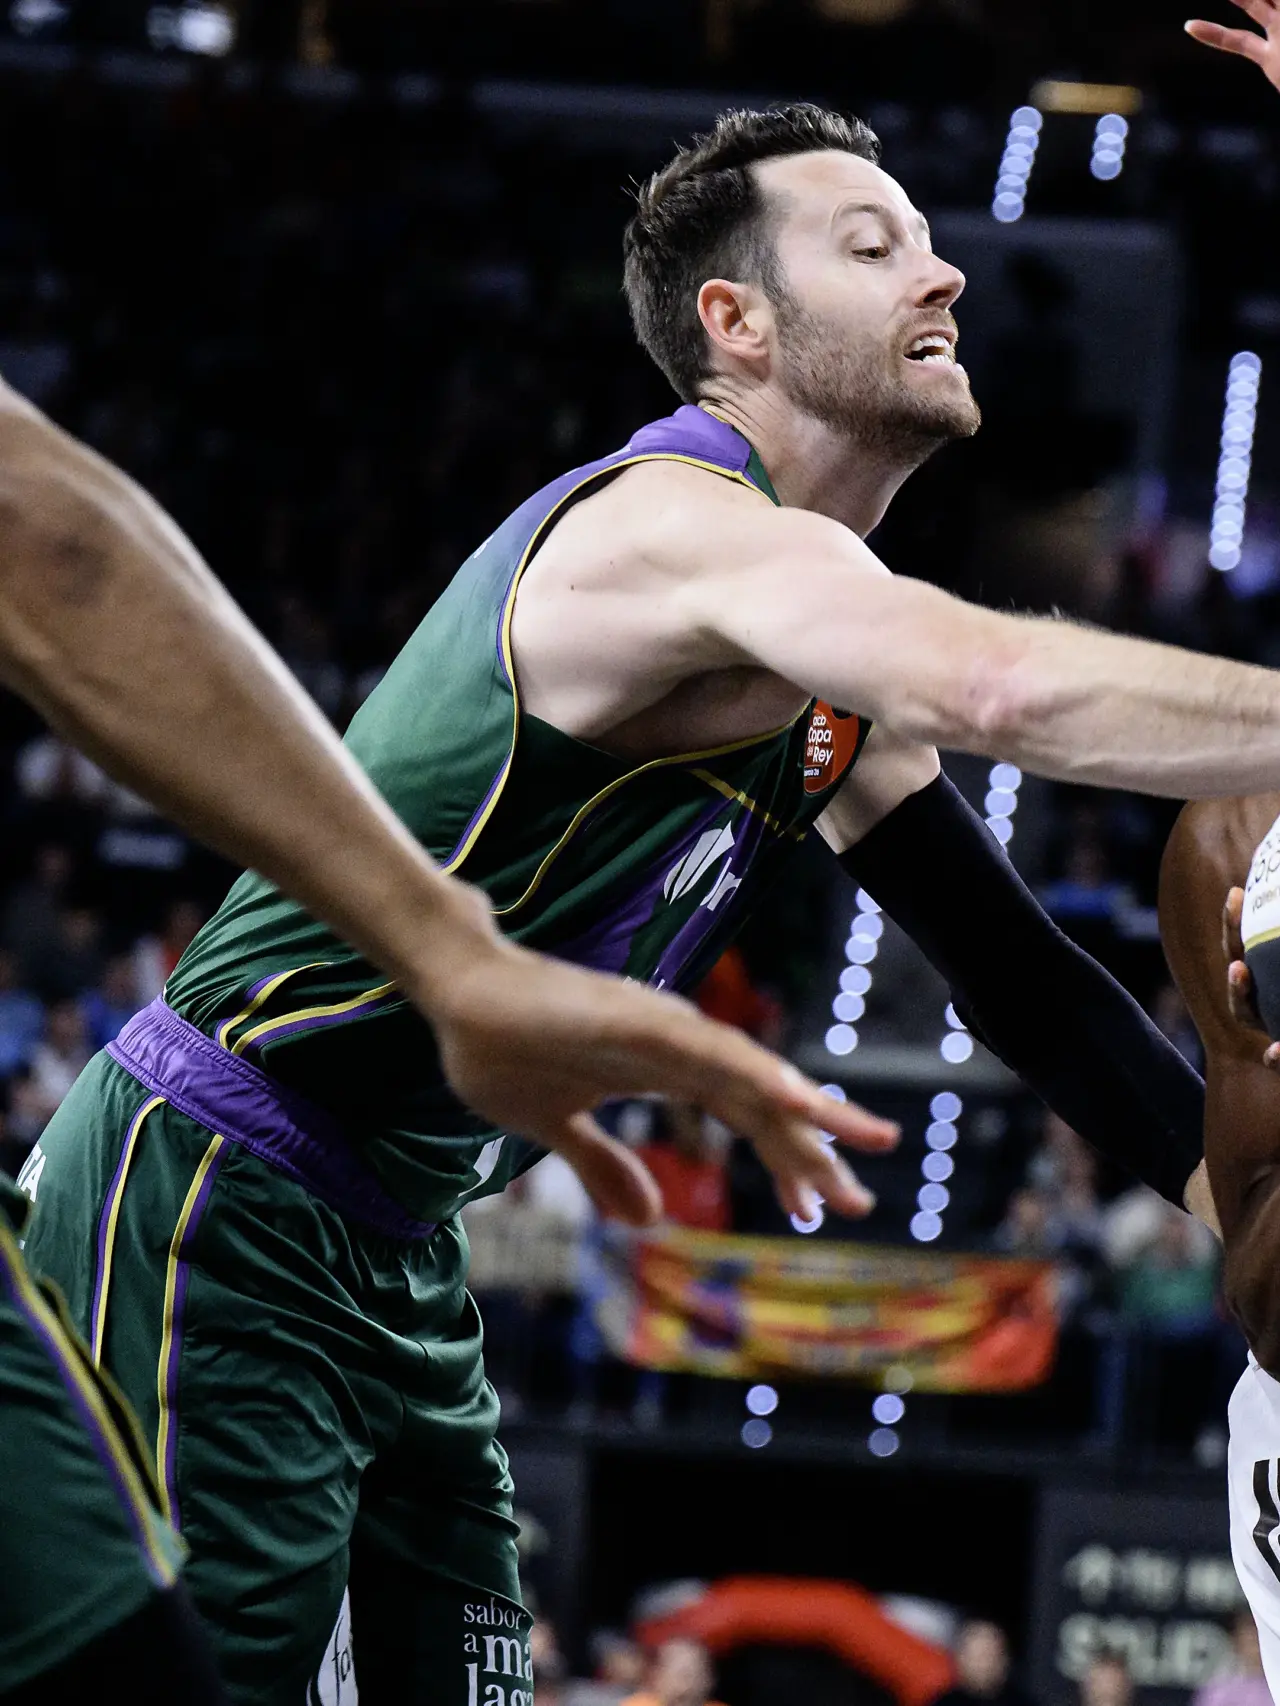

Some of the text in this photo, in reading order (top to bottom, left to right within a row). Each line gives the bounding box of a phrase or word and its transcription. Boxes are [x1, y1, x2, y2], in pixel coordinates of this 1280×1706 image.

[813, 714, 826, 726] acb
[808, 727, 832, 745] Copa
[813, 745, 833, 766] Rey
[463, 1597, 526, 1630] sabor
[464, 1632, 480, 1653] a
